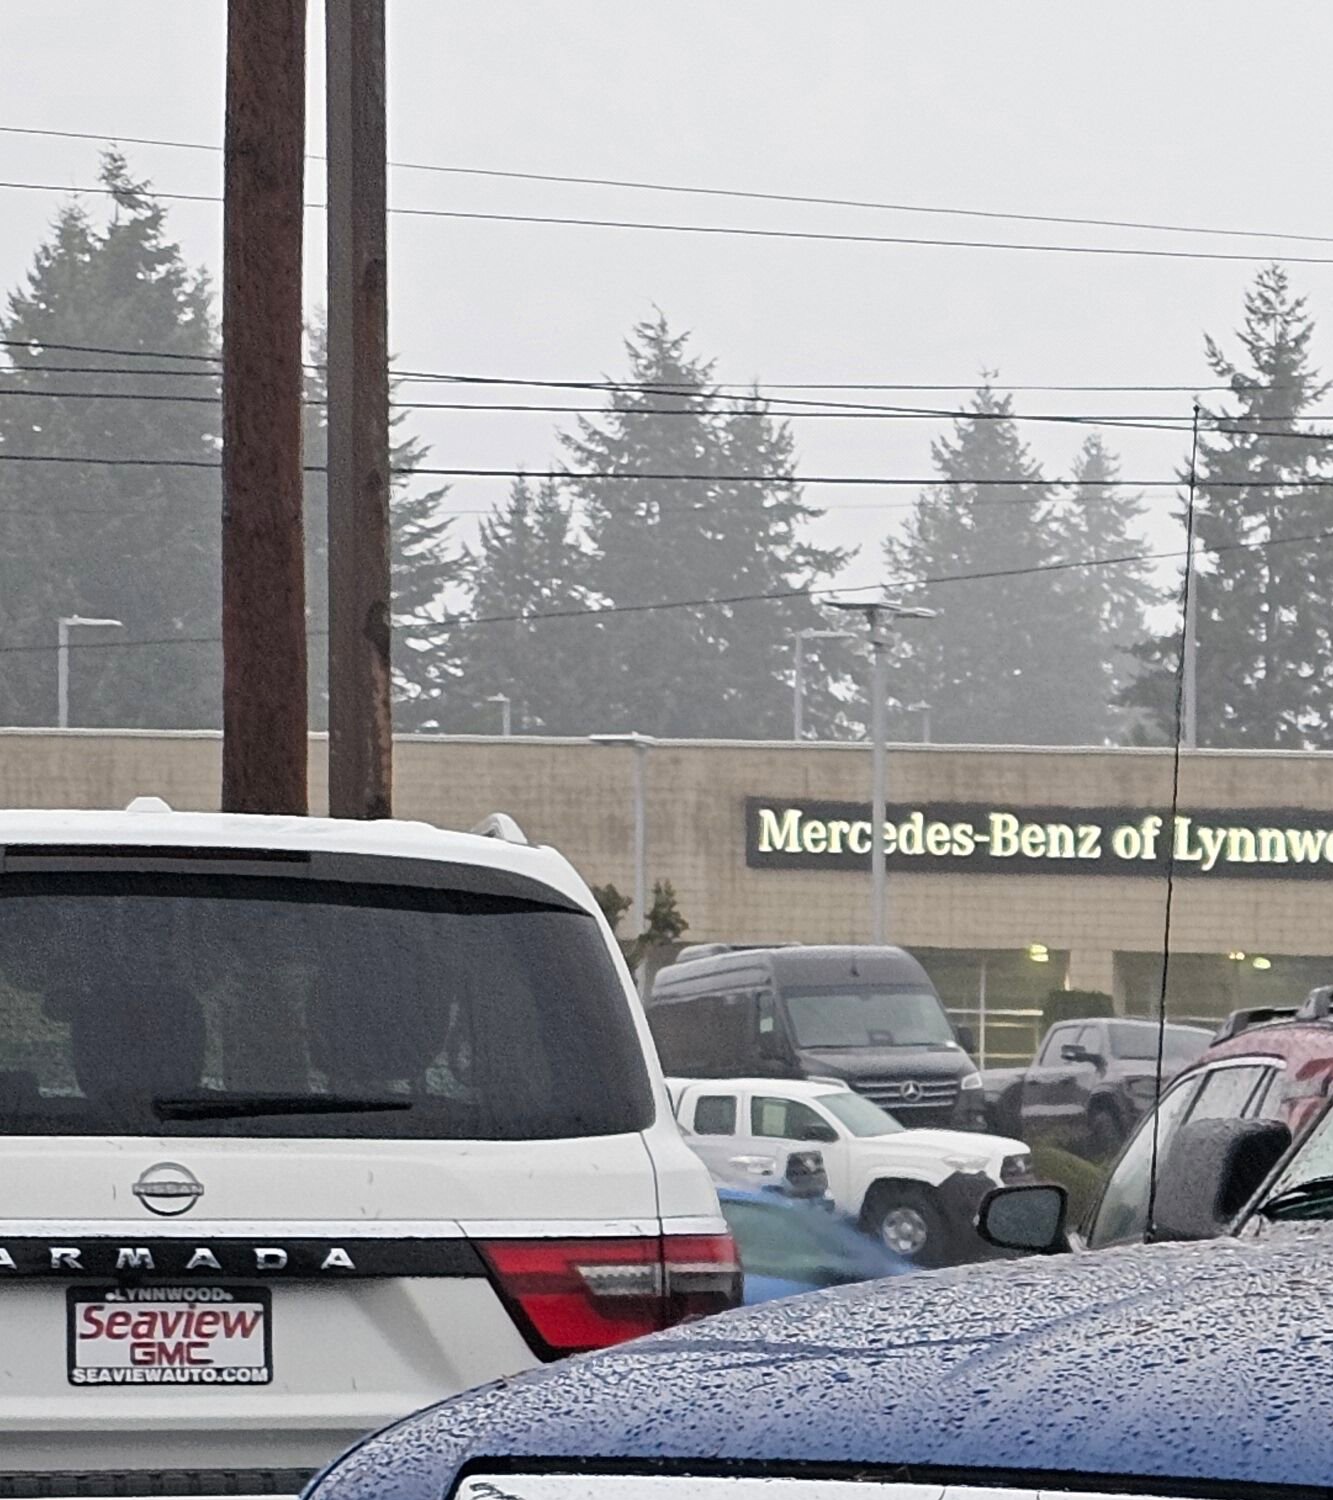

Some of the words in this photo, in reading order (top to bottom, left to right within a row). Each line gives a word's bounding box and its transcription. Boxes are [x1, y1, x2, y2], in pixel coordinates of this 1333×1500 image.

[1112, 815, 1163, 859] of
[115, 1287, 225, 1301] LYNNWOOD
[79, 1303, 263, 1339] Seaview
[130, 1342, 214, 1365] GMC
[72, 1368, 268, 1383] SEAVIEWAUTO.COM
